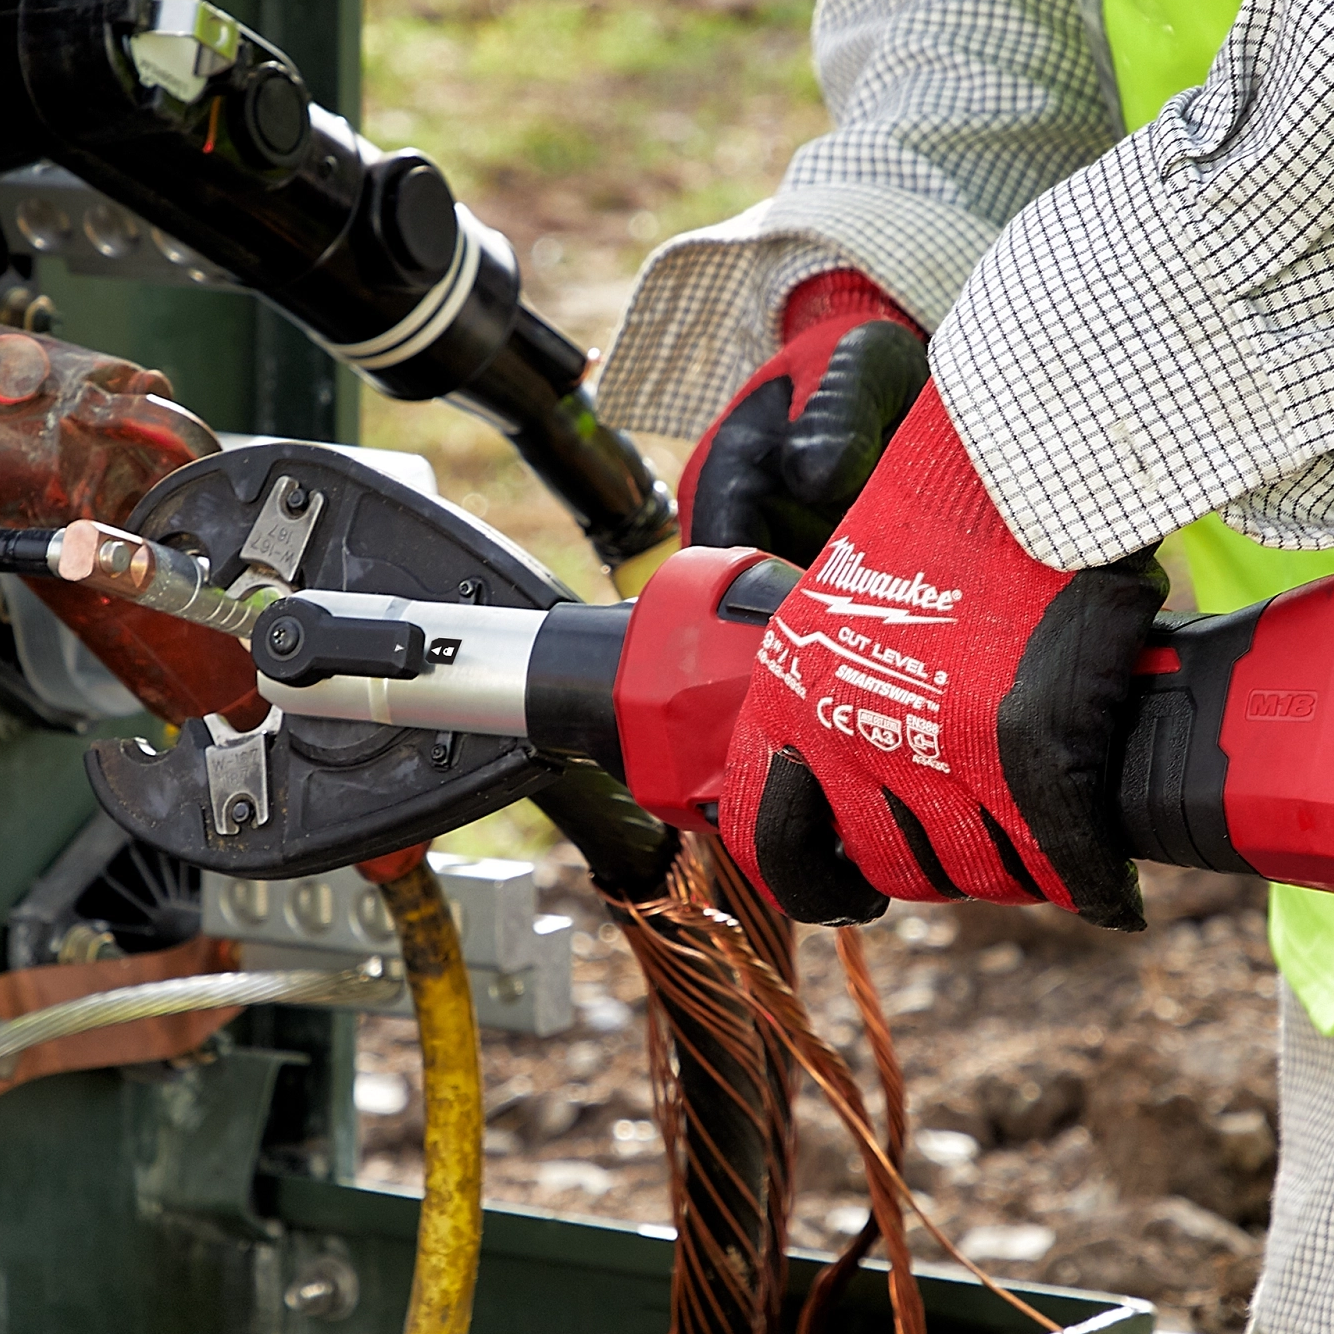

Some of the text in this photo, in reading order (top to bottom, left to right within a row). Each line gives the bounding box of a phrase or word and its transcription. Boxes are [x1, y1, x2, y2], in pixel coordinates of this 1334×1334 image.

[838, 626, 948, 686] CUT LEVEL 3
[1249, 694, 1316, 717] M18
[871, 727, 895, 745] A3
